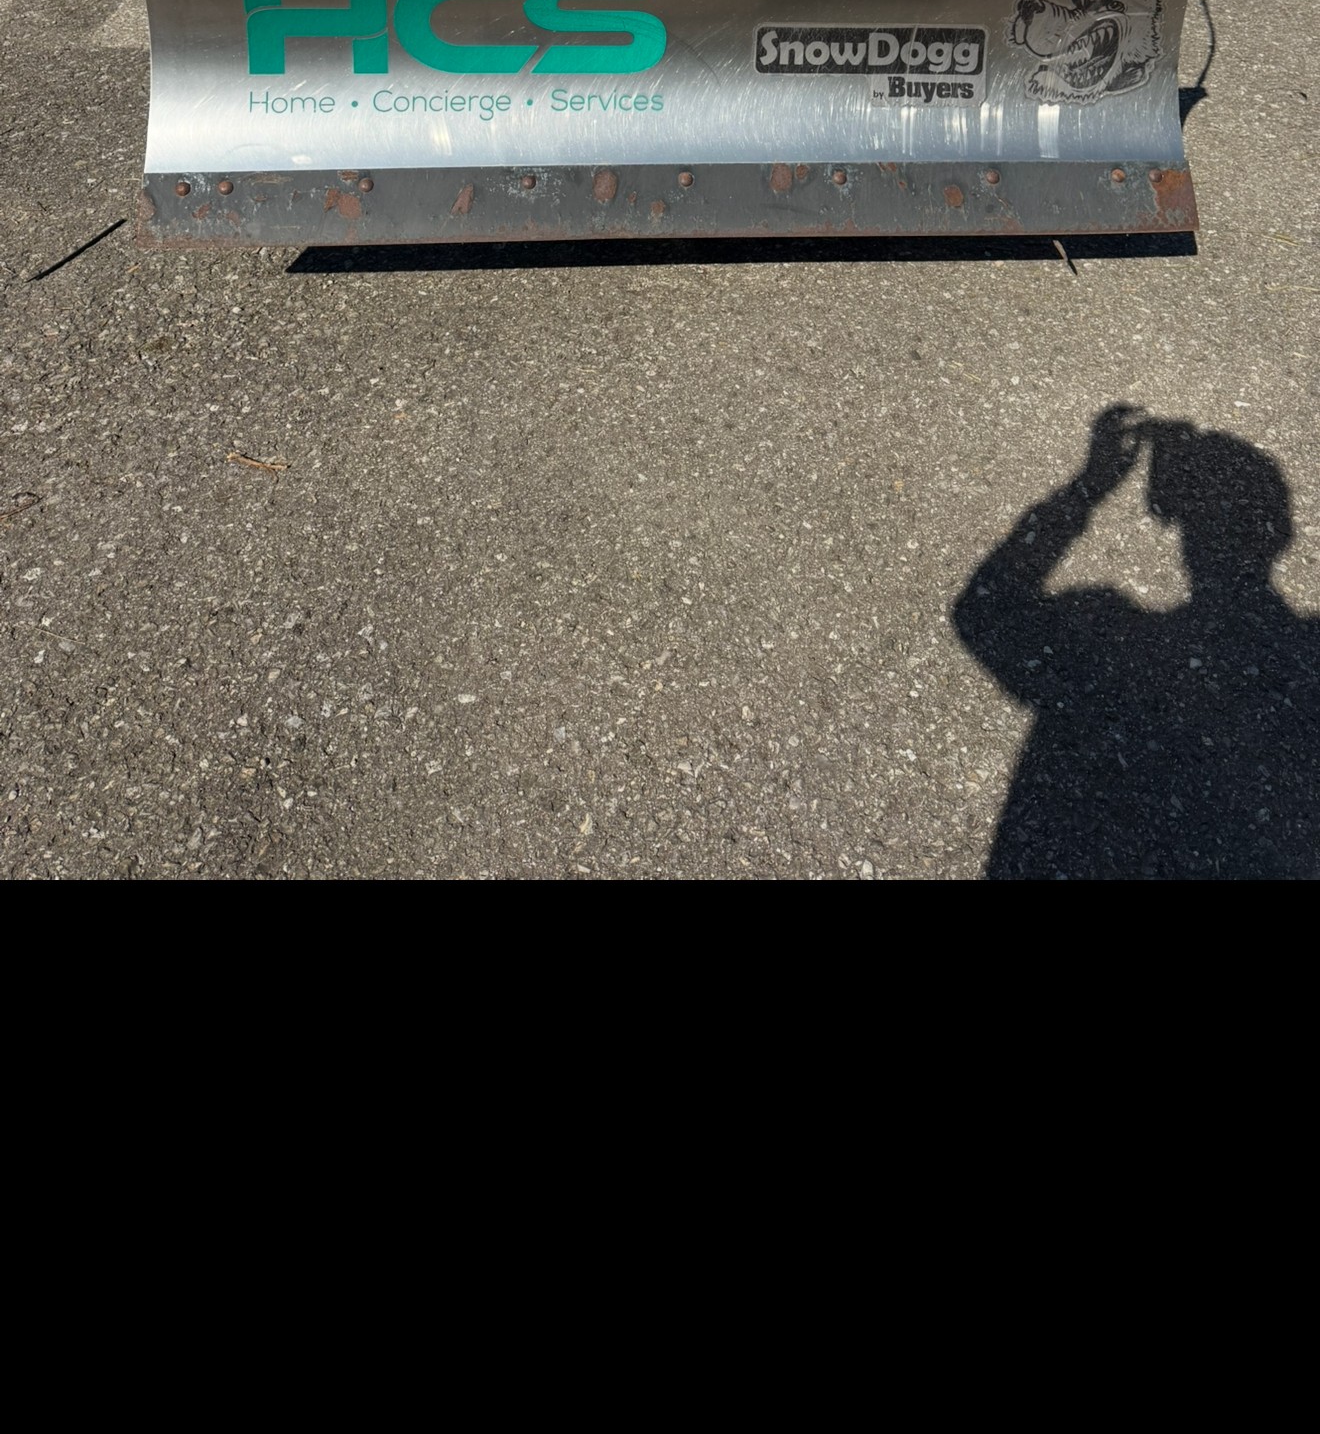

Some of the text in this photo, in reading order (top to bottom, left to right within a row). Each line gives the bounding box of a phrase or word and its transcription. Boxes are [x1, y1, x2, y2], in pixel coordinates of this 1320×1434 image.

[759, 30, 980, 72] SnowDogg
[248, 88, 665, 121] Home Concierge Services
[873, 76, 974, 103] by Buyers
